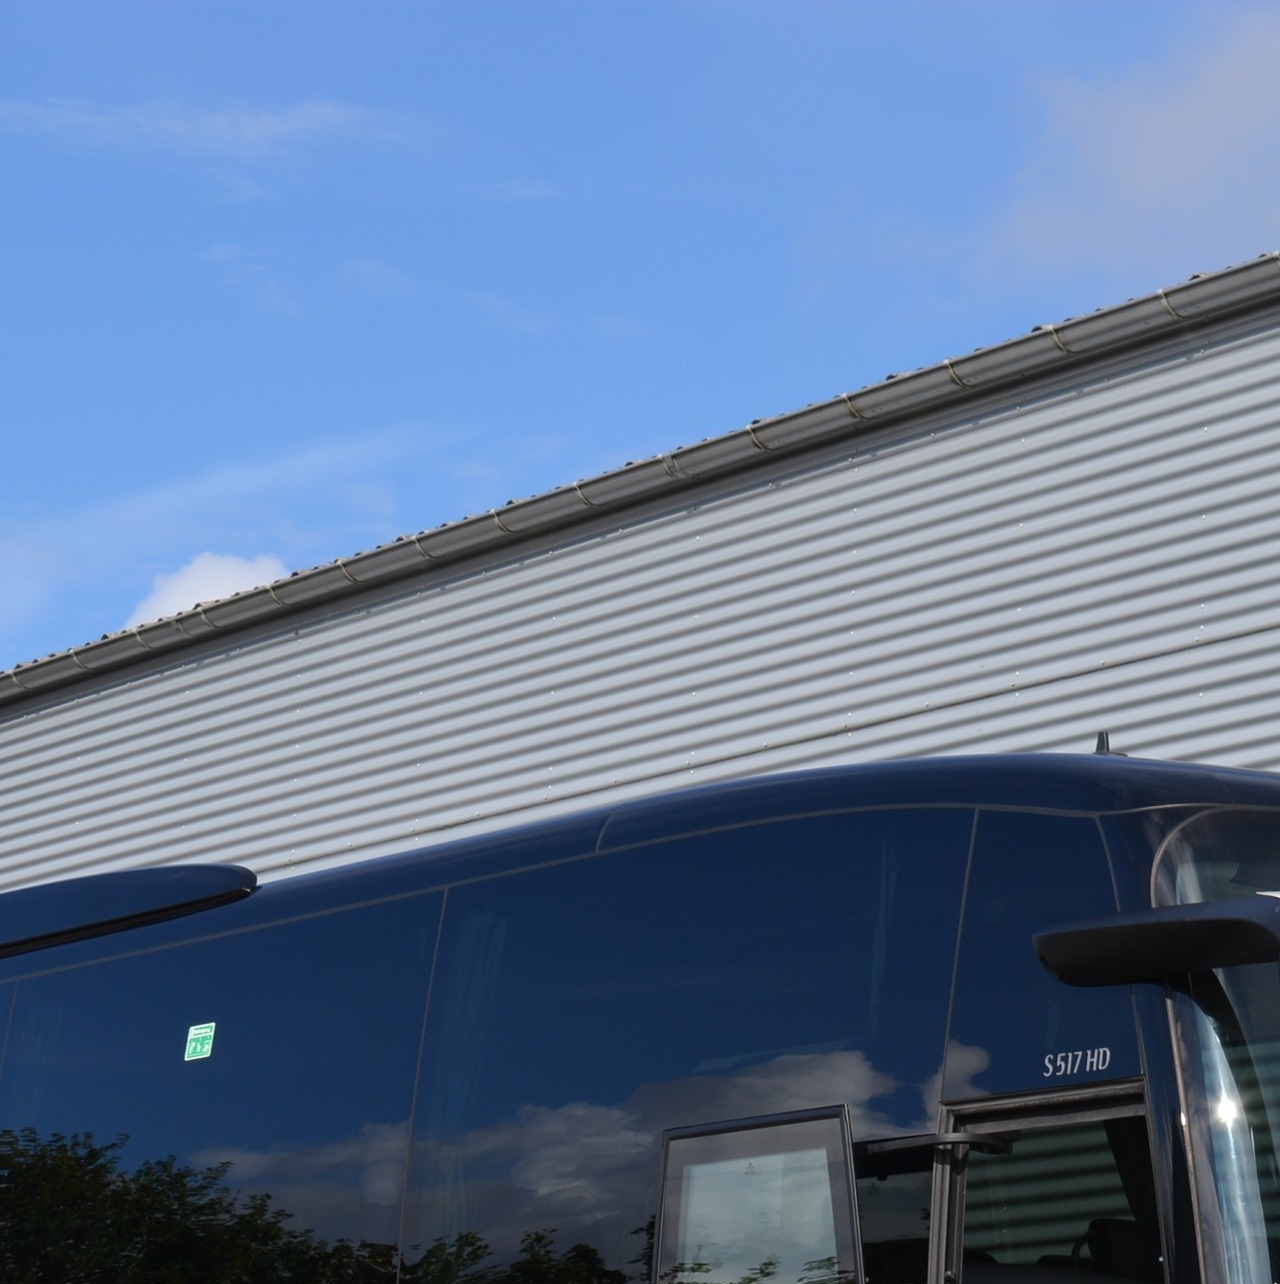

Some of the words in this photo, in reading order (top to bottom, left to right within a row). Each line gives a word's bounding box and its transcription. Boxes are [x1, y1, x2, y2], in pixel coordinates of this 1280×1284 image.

[1043, 1054, 1053, 1077] S
[1056, 1051, 1082, 1075] 517
[1086, 1047, 1110, 1072] HD
